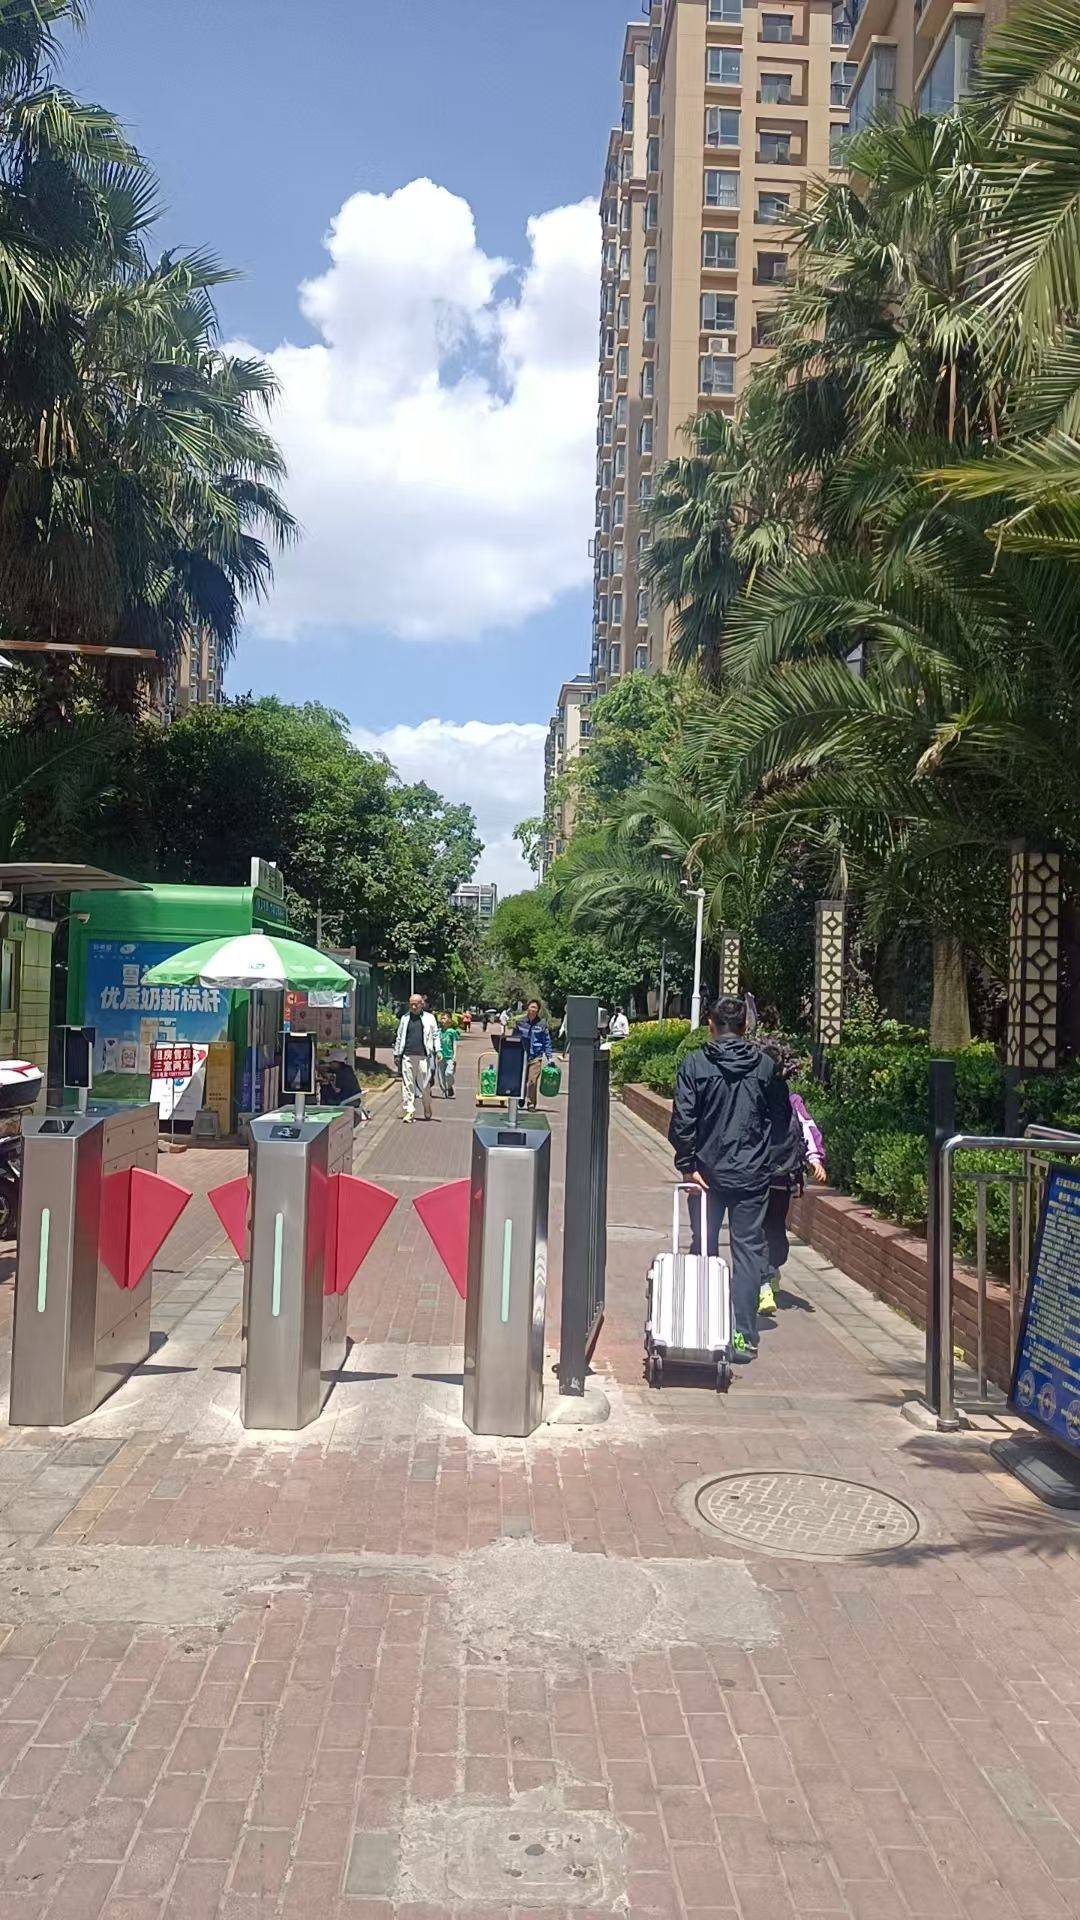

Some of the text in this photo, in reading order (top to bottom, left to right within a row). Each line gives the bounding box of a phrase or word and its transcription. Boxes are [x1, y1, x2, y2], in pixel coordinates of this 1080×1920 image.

[100, 985, 220, 1012] 优质奶新标杆
